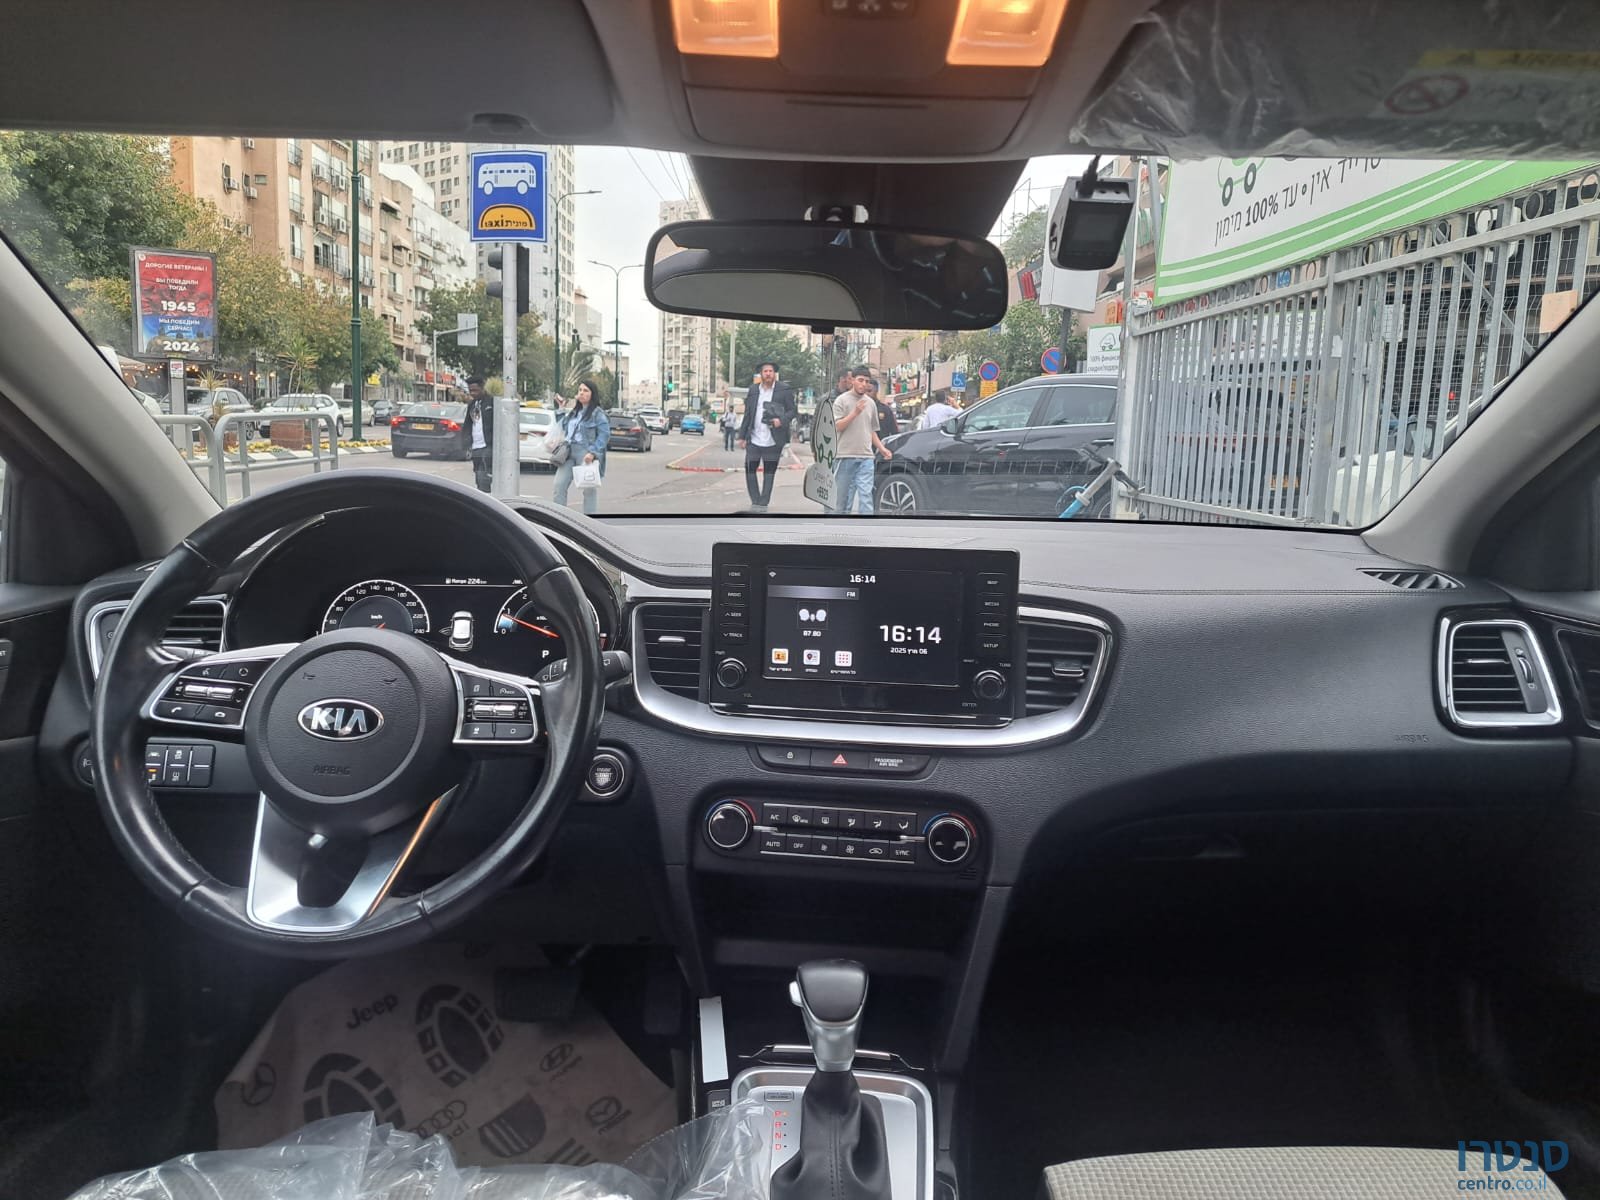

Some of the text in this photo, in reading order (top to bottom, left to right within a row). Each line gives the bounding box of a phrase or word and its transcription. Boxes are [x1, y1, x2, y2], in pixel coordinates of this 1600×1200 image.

[1309, 165, 1333, 206] אין
[1282, 182, 1299, 210] עד
[1244, 191, 1279, 228] 100%
[484, 214, 528, 228] taxi מונית
[1214, 210, 1243, 249] מימון
[145, 262, 173, 270] ДОРОГИЕ
[169, 284, 187, 292] ТОГДА
[161, 300, 196, 313] 1945
[163, 340, 200, 353] 2024
[850, 574, 876, 584] 16:14
[846, 590, 856, 598] FM
[879, 624, 942, 644] 16:14
[541, 650, 550, 659] P
[890, 646, 907, 654] 2025
[310, 707, 368, 733] KIA
[770, 813, 780, 821] A/C
[765, 840, 781, 848] AUTO
[346, 994, 399, 1030] Jeep
